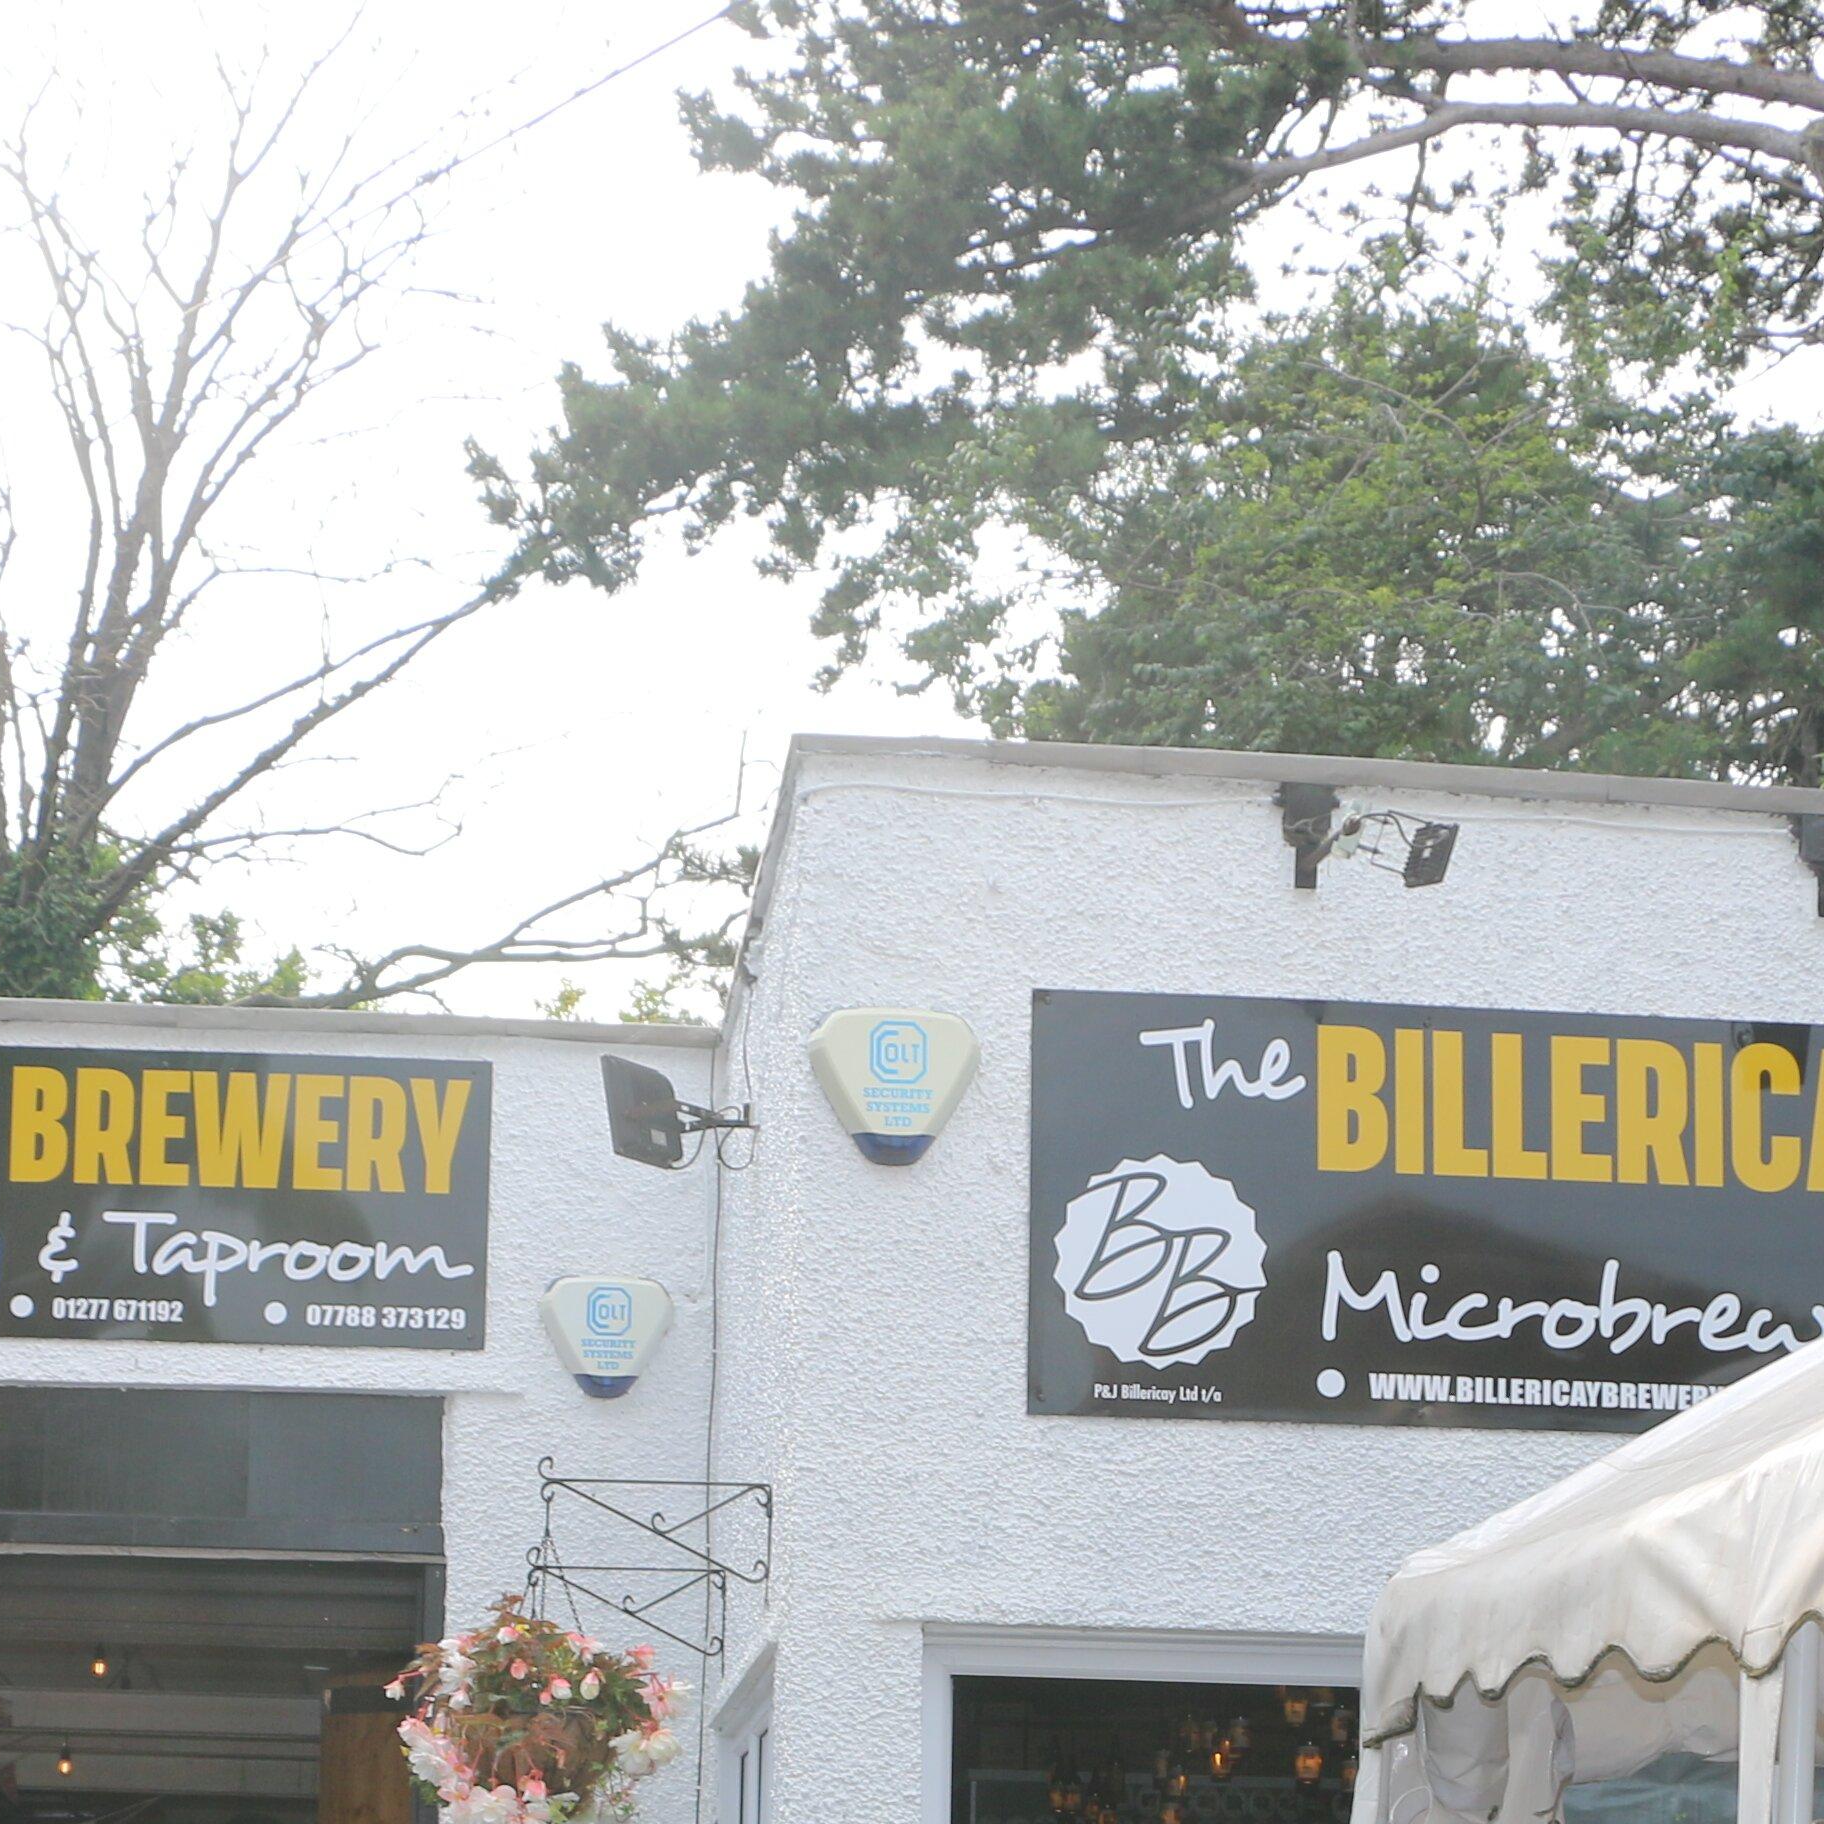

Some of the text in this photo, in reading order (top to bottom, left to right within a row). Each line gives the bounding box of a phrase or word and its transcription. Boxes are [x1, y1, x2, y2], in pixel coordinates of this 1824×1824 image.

[1139, 1018, 1306, 1109] The
[863, 1087, 932, 1099] SECURITY
[867, 1102, 930, 1113] SYSTEMS
[885, 1116, 912, 1127] LTD
[9, 1066, 472, 1195] BREWERY
[39, 1211, 78, 1283] &
[103, 1210, 473, 1307] Taproom
[51, 1294, 108, 1321] 01277
[112, 1298, 184, 1323] 671192
[306, 1302, 376, 1328] 07788
[381, 1306, 466, 1330] 373129
[1093, 1383, 1223, 1404] P&J Billericay Ltd t/a
